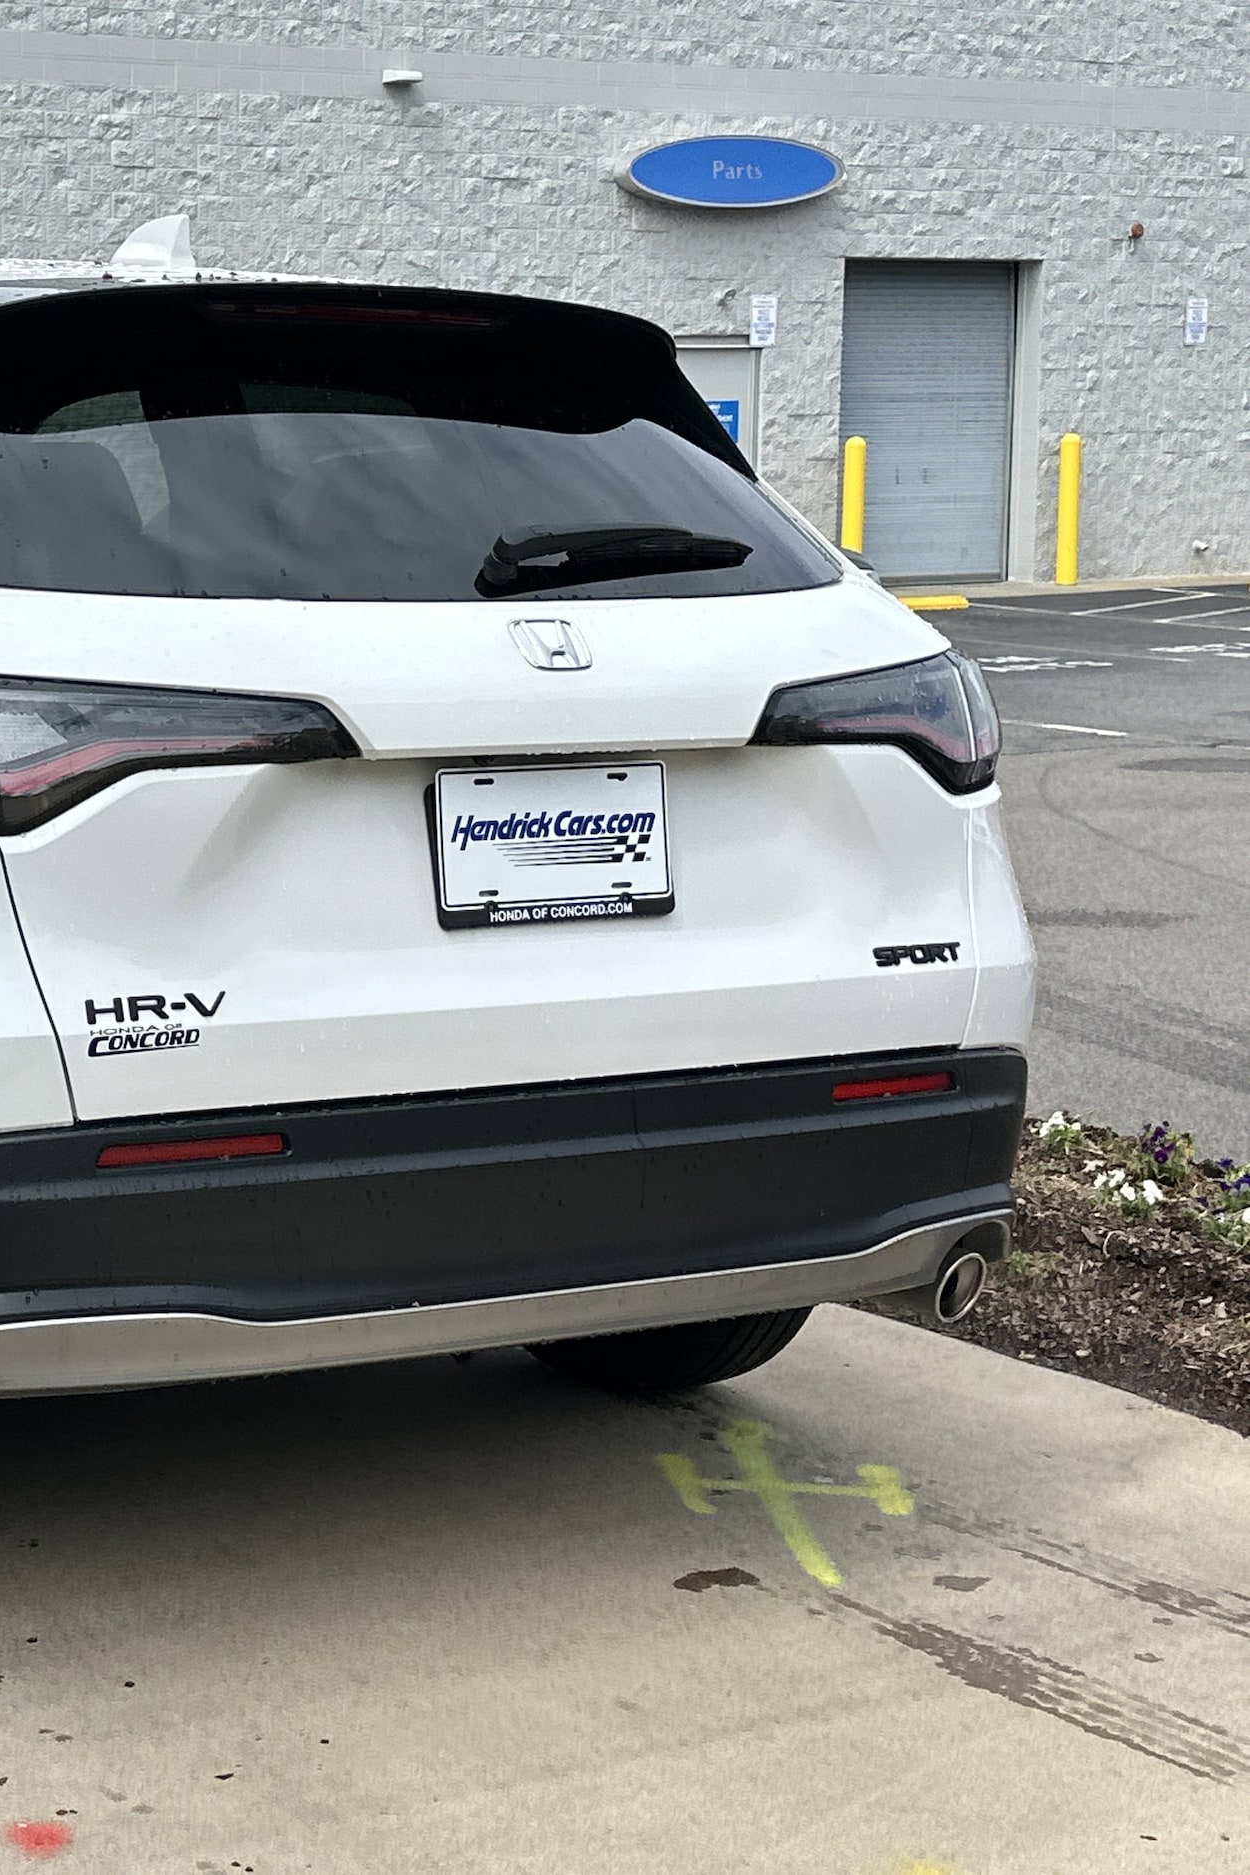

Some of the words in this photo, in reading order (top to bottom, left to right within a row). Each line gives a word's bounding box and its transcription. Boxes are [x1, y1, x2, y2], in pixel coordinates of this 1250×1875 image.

[712, 160, 763, 180] Parts
[490, 907, 530, 923] HONDA
[533, 904, 548, 919] OF
[550, 902, 633, 918] CONCORD.COM
[872, 941, 961, 967] SPORT
[84, 990, 226, 1025] HR-V
[88, 1028, 200, 1057] CONCORD
[90, 1025, 160, 1037] HONDA
